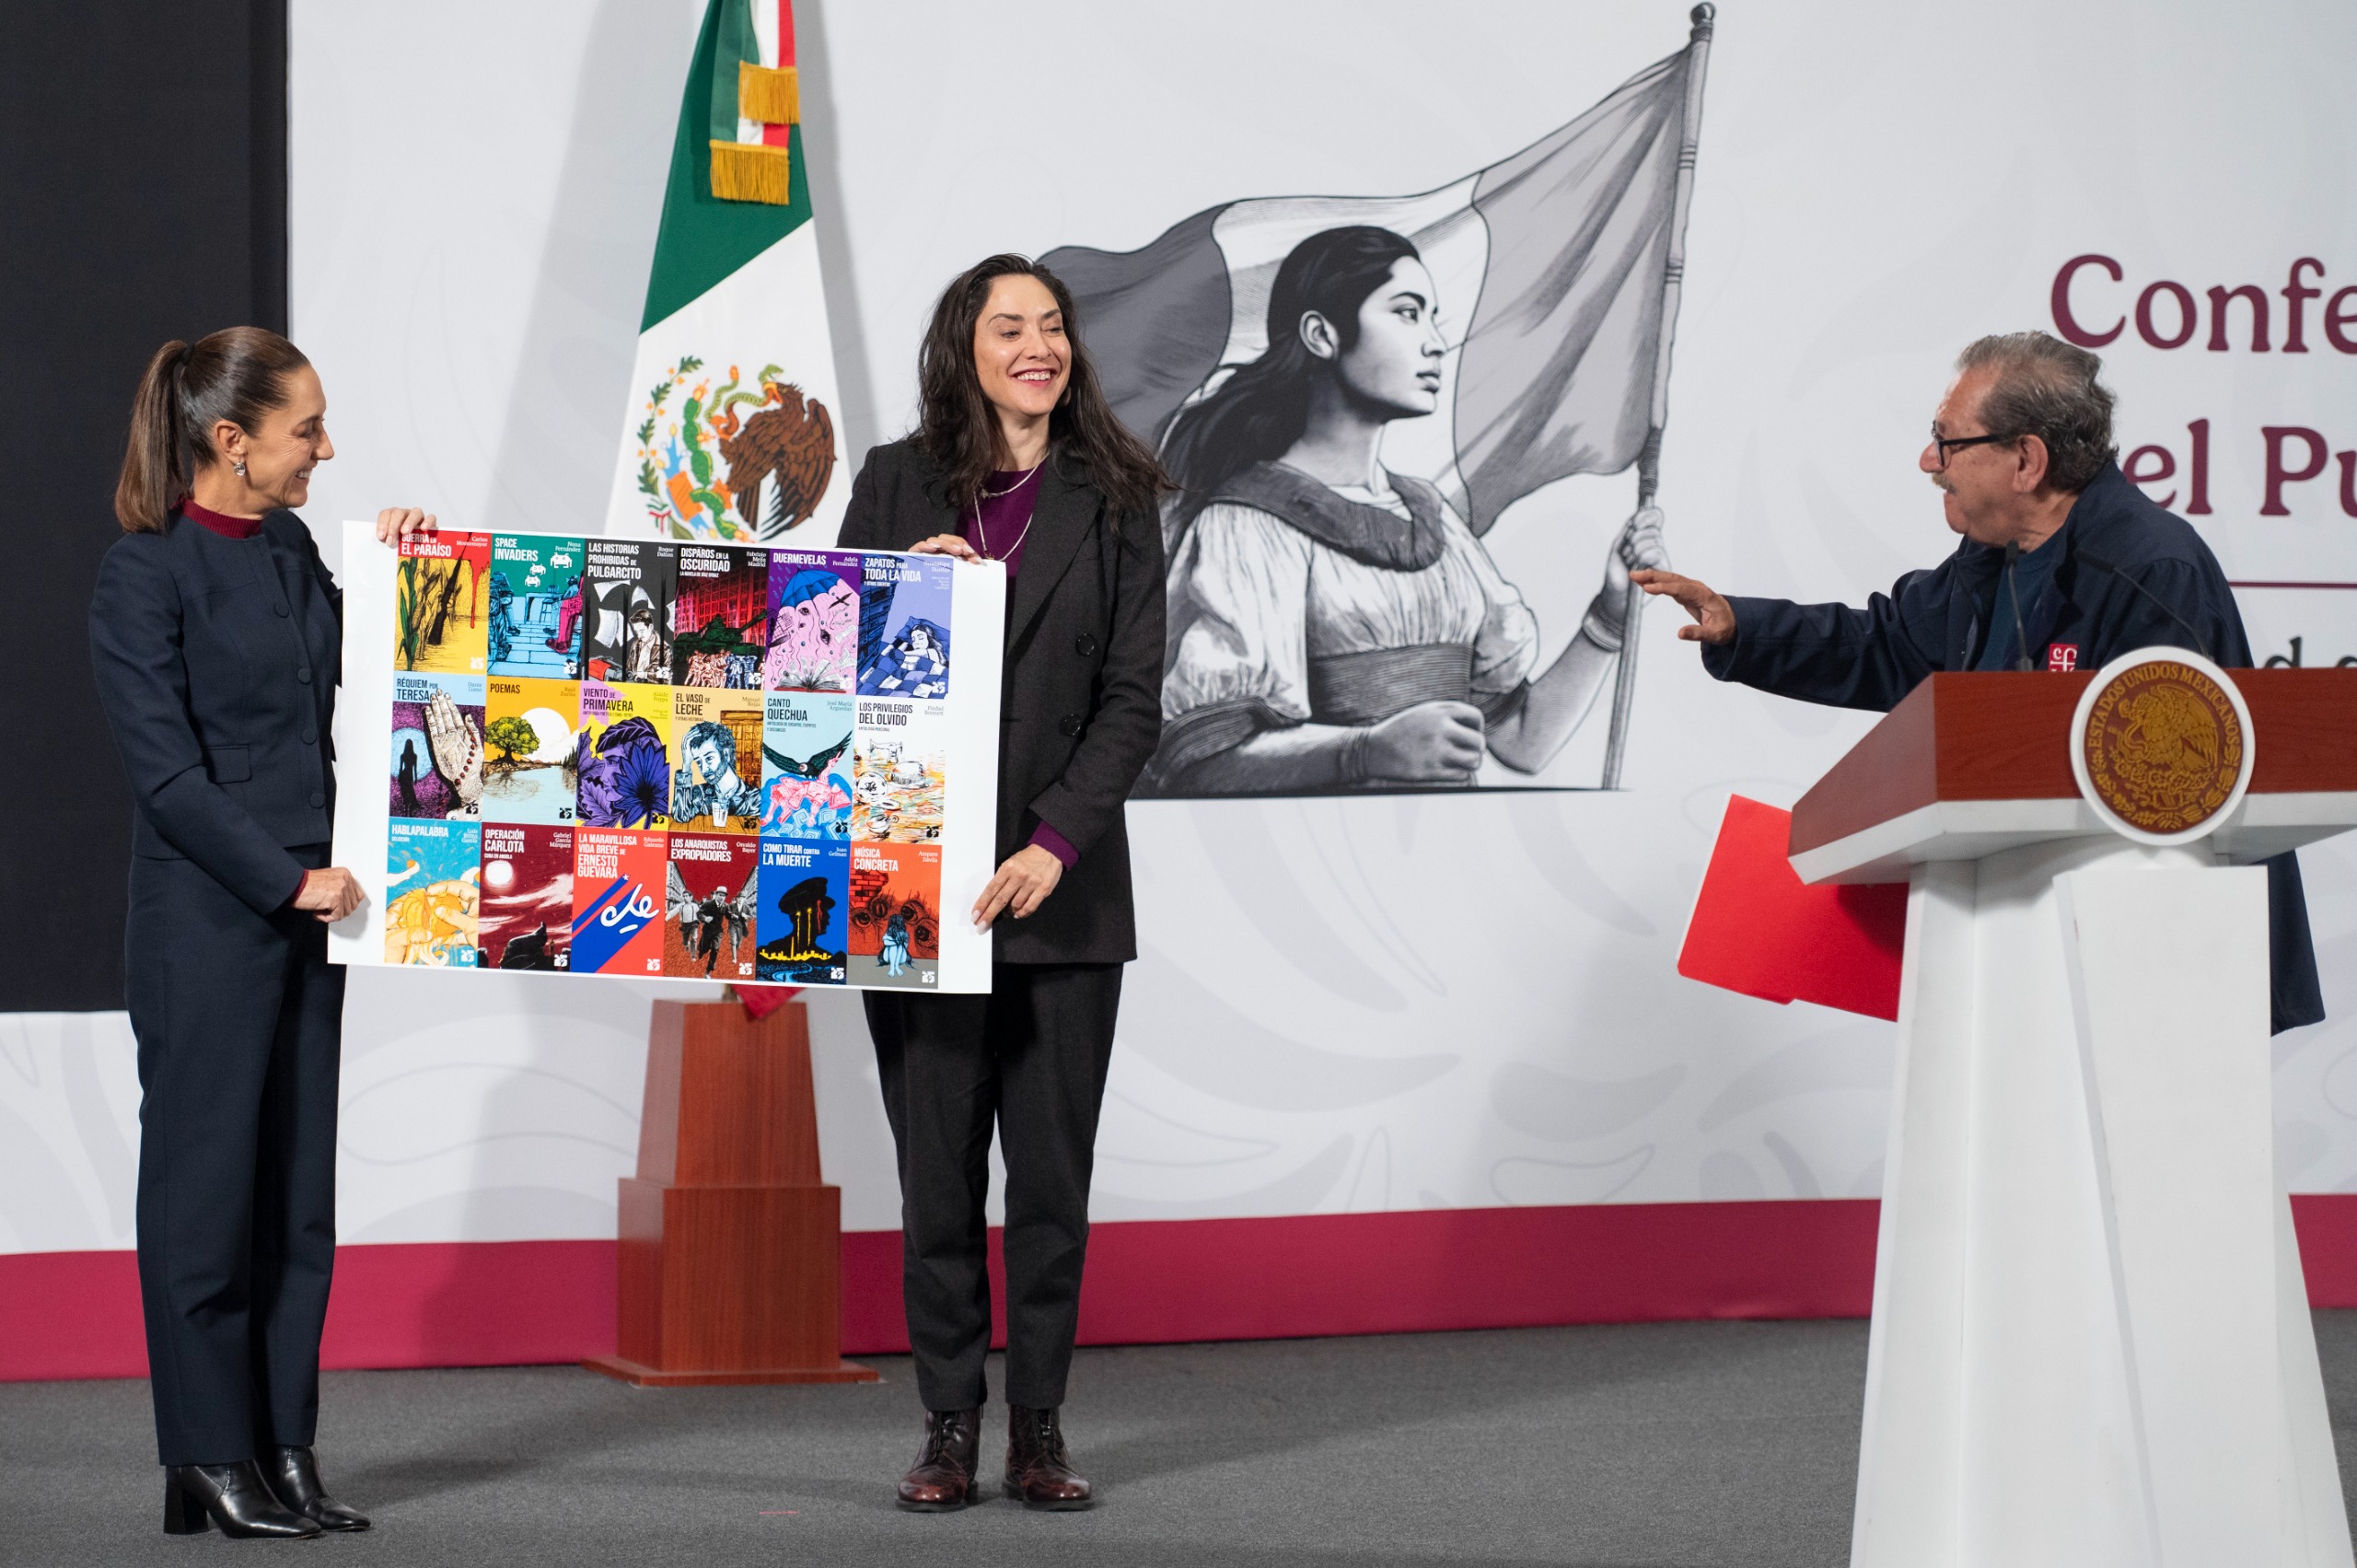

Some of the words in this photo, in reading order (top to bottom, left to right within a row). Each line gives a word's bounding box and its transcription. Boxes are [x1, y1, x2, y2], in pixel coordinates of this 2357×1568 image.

[2051, 254, 2357, 354] Confe
[401, 534, 429, 543] GUERRA
[495, 538, 517, 548] SPACE
[401, 543, 412, 555] EL
[414, 543, 451, 556] PARAÍSO
[588, 543, 601, 552] LAS
[603, 543, 639, 554] HISTORIAS
[681, 548, 714, 559] DISPAROS
[494, 551, 538, 562] INVADERS
[588, 554, 629, 565] PROHIBIDAS
[773, 552, 826, 565] DUERMEVELAS
[680, 559, 730, 572] OSCURIDAD
[865, 558, 895, 568] ZAPATOS
[587, 565, 641, 579] PULGARCITO
[865, 569, 888, 580] TODA
[889, 570, 900, 581] LA
[902, 571, 921, 582] VIDA
[397, 679, 427, 689] RÉQUIEM
[490, 683, 520, 694] POEMAS
[397, 690, 430, 701] TERESA
[584, 688, 608, 698] VIENTO
[676, 693, 684, 703] EL
[686, 693, 703, 703] VASO
[584, 699, 633, 712] PRIMAVERA
[768, 698, 790, 708] CANTO
[859, 703, 872, 712] LOS
[873, 703, 913, 714] PRIVILEGIOS
[2087, 681, 2126, 748] ESTADOS
[2124, 664, 2178, 689] UNIDOS
[2180, 667, 2239, 744] MEXICANOS
[676, 703, 702, 715] LECHE
[768, 709, 807, 721] QUECHUA
[859, 714, 874, 725] DEL
[877, 714, 907, 726] OLVIDO
[392, 824, 448, 837] HABLAPALABRA
[485, 829, 525, 840] OPERACIÓN
[578, 833, 587, 843] LA
[589, 834, 637, 845] MARAVILLOSA
[671, 839, 683, 848] LOS
[684, 840, 727, 850] ANARQUISTAS
[484, 840, 524, 853] CARLOTA
[578, 843, 595, 854] VIDA
[597, 844, 618, 854] BREVE
[763, 843, 782, 853] COMO
[784, 844, 802, 854] TIRAR
[671, 851, 731, 862] EXPROPIADORES
[854, 847, 880, 858] MÚSICA
[578, 854, 618, 866] ERNESTO
[763, 854, 774, 865] LA
[776, 854, 811, 867] MUERTE
[854, 858, 899, 872] CONCRETA
[578, 866, 618, 878] GUEVARA
